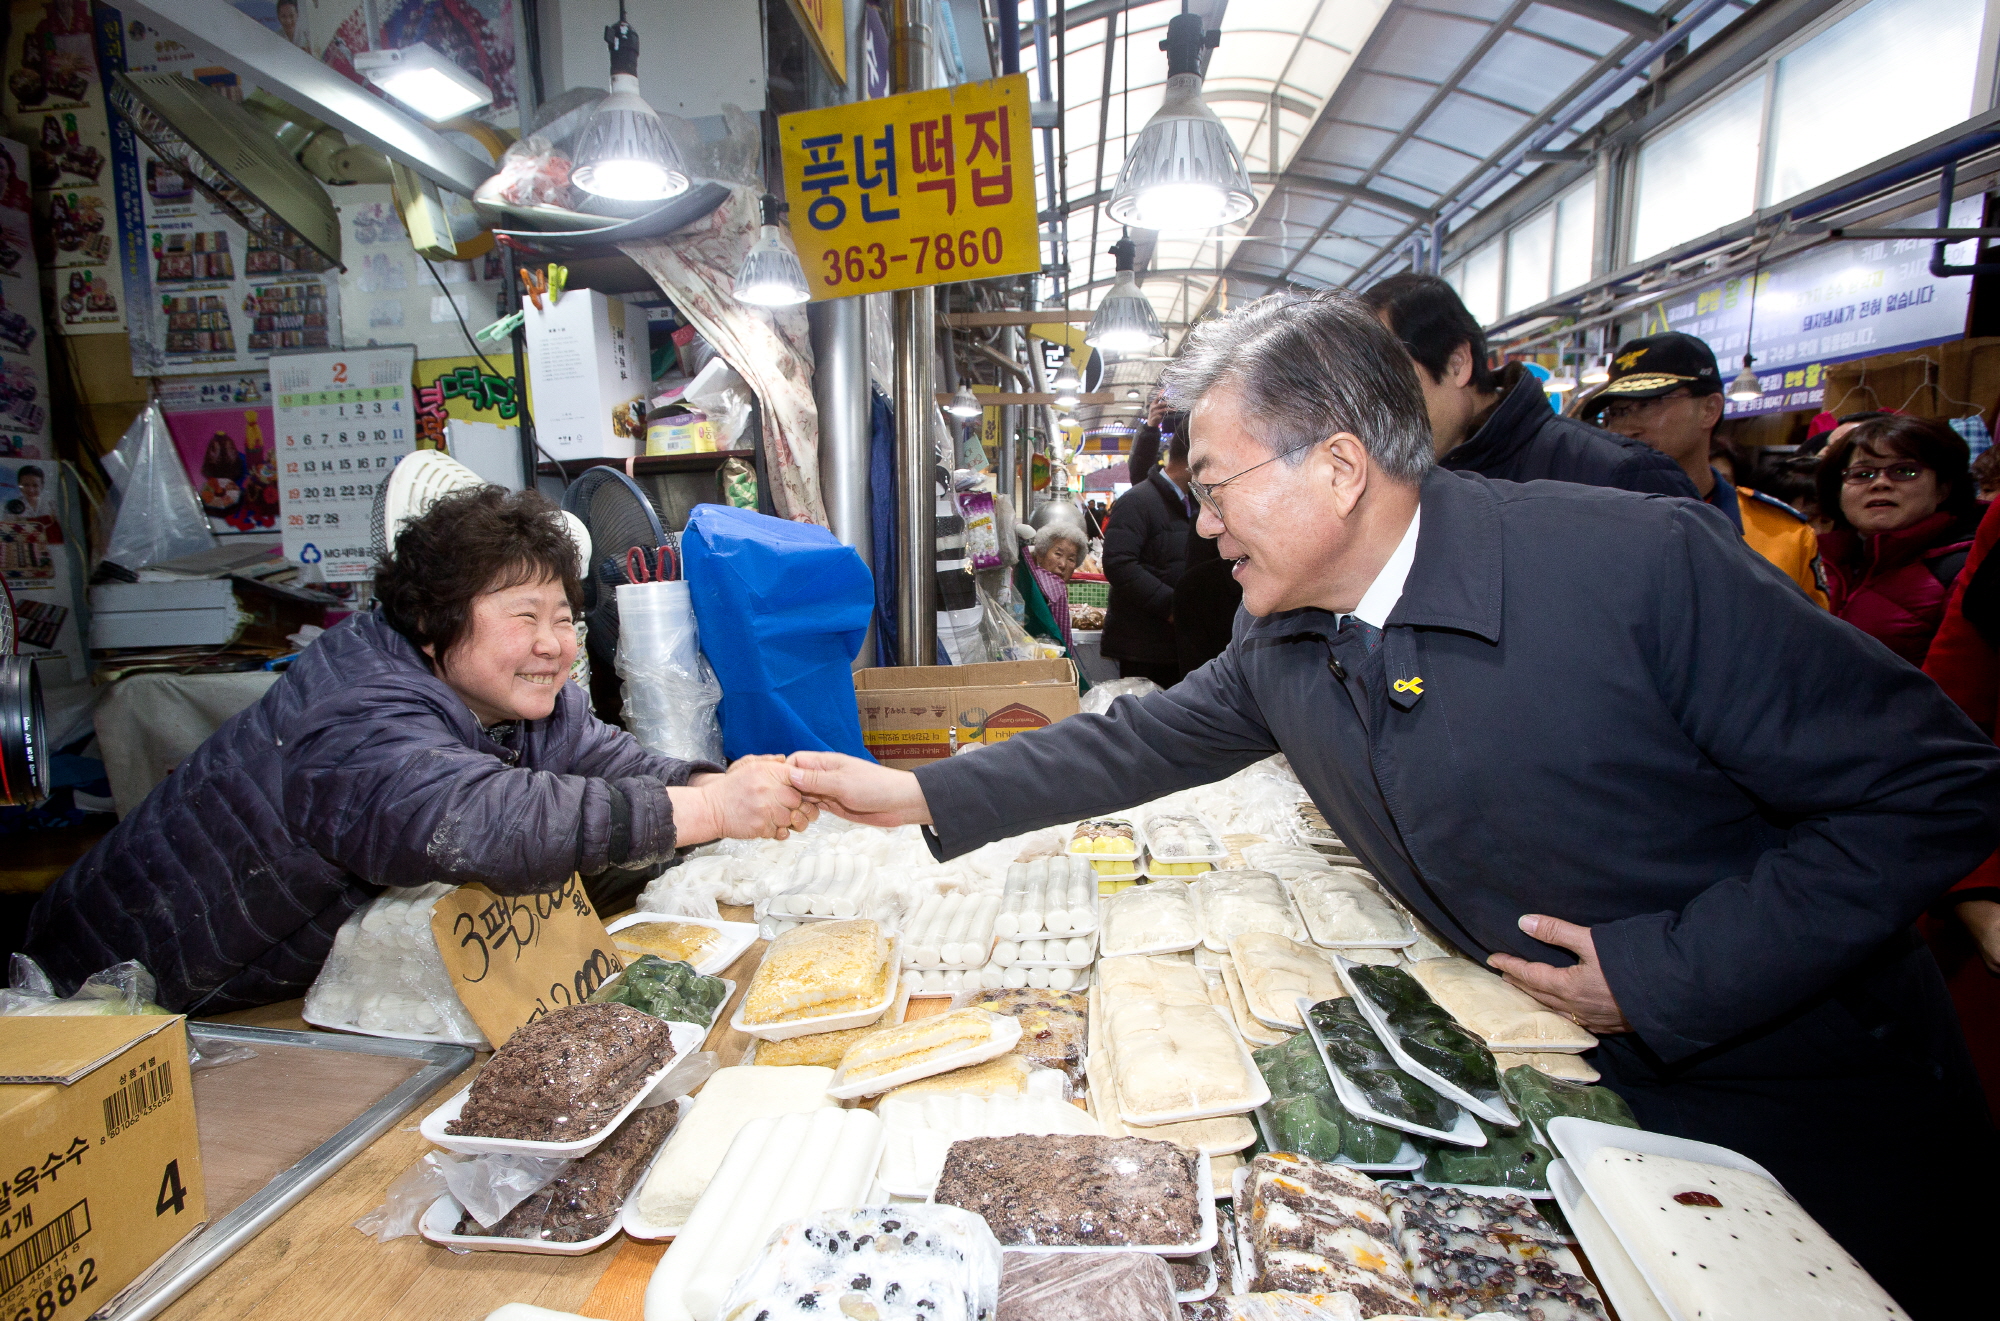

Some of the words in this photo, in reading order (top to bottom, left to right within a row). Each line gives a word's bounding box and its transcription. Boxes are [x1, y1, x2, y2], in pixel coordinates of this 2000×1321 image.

[802, 123, 900, 231] 풍년
[910, 105, 1014, 216] 떡집
[822, 227, 1003, 286] 363-7860
[1723, 279, 1742, 310] 왕
[332, 362, 348, 383] 2
[439, 366, 519, 419] 떡집
[339, 406, 344, 416] 1
[355, 403, 364, 415] 2
[373, 402, 382, 414] 3
[391, 401, 400, 412] 4
[286, 435, 295, 446] 5
[303, 434, 312, 446] 6
[321, 433, 329, 444] 7
[339, 431, 348, 443] 8
[357, 430, 366, 442] 9
[373, 430, 386, 441] 10
[393, 429, 404, 439] 11
[286, 462, 299, 473] 12
[303, 461, 316, 473] 13
[321, 460, 333, 471] 14
[339, 459, 352, 470] 15
[357, 457, 370, 469] 16
[375, 456, 387, 468] 17
[288, 488, 300, 500] 19
[303, 487, 319, 499] 20
[323, 486, 336, 497] 21
[340, 484, 355, 496] 22
[357, 483, 373, 496] 23
[288, 514, 304, 526] 26
[306, 513, 320, 525] 27
[323, 512, 339, 524] 28
[878, 732, 900, 741] 맛있는
[901, 733, 930, 741] 건강하고
[903, 747, 921, 755] 전문가
[119, 1056, 157, 1085] 상품개별
[100, 1136, 106, 1146] 8
[110, 1113, 140, 1139] 801062
[143, 1093, 171, 1117] 435692
[156, 1158, 188, 1217] 4
